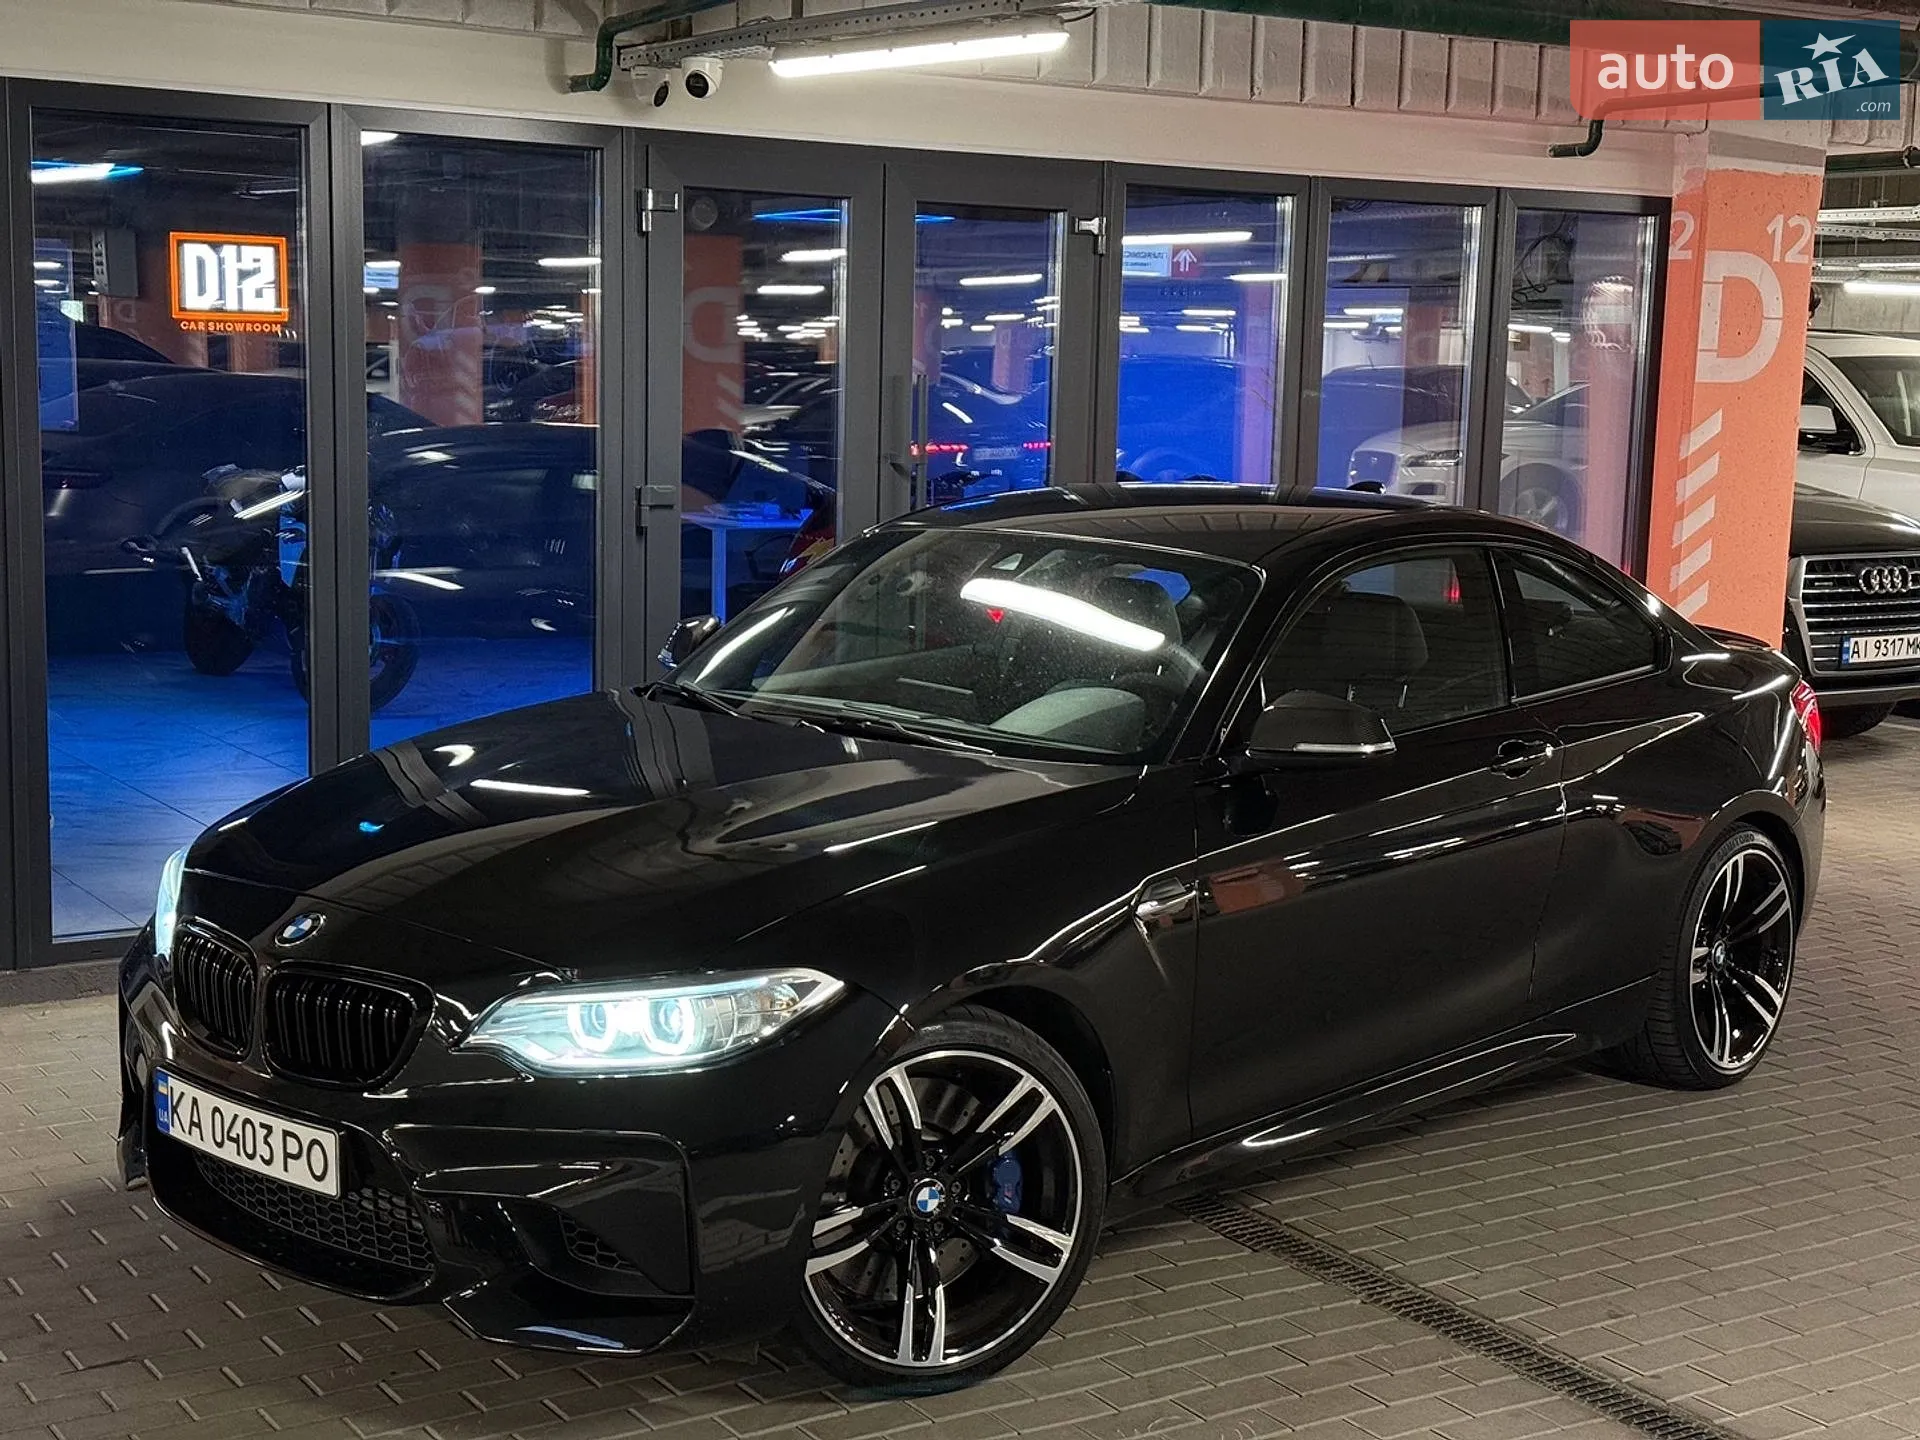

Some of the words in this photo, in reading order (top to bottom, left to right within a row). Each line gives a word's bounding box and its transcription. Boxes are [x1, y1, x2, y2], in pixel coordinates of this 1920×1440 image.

[1766, 214, 1812, 264] 12
[183, 243, 276, 312] D12
[180, 321, 205, 331] CAR
[207, 321, 281, 333] SHOWROOM
[1696, 250, 1783, 382] D
[1851, 640, 1868, 658] AI
[1874, 638, 1905, 657] 9317
[170, 1086, 204, 1142] KA
[211, 1105, 274, 1167] 0403
[281, 1127, 328, 1182] PO
